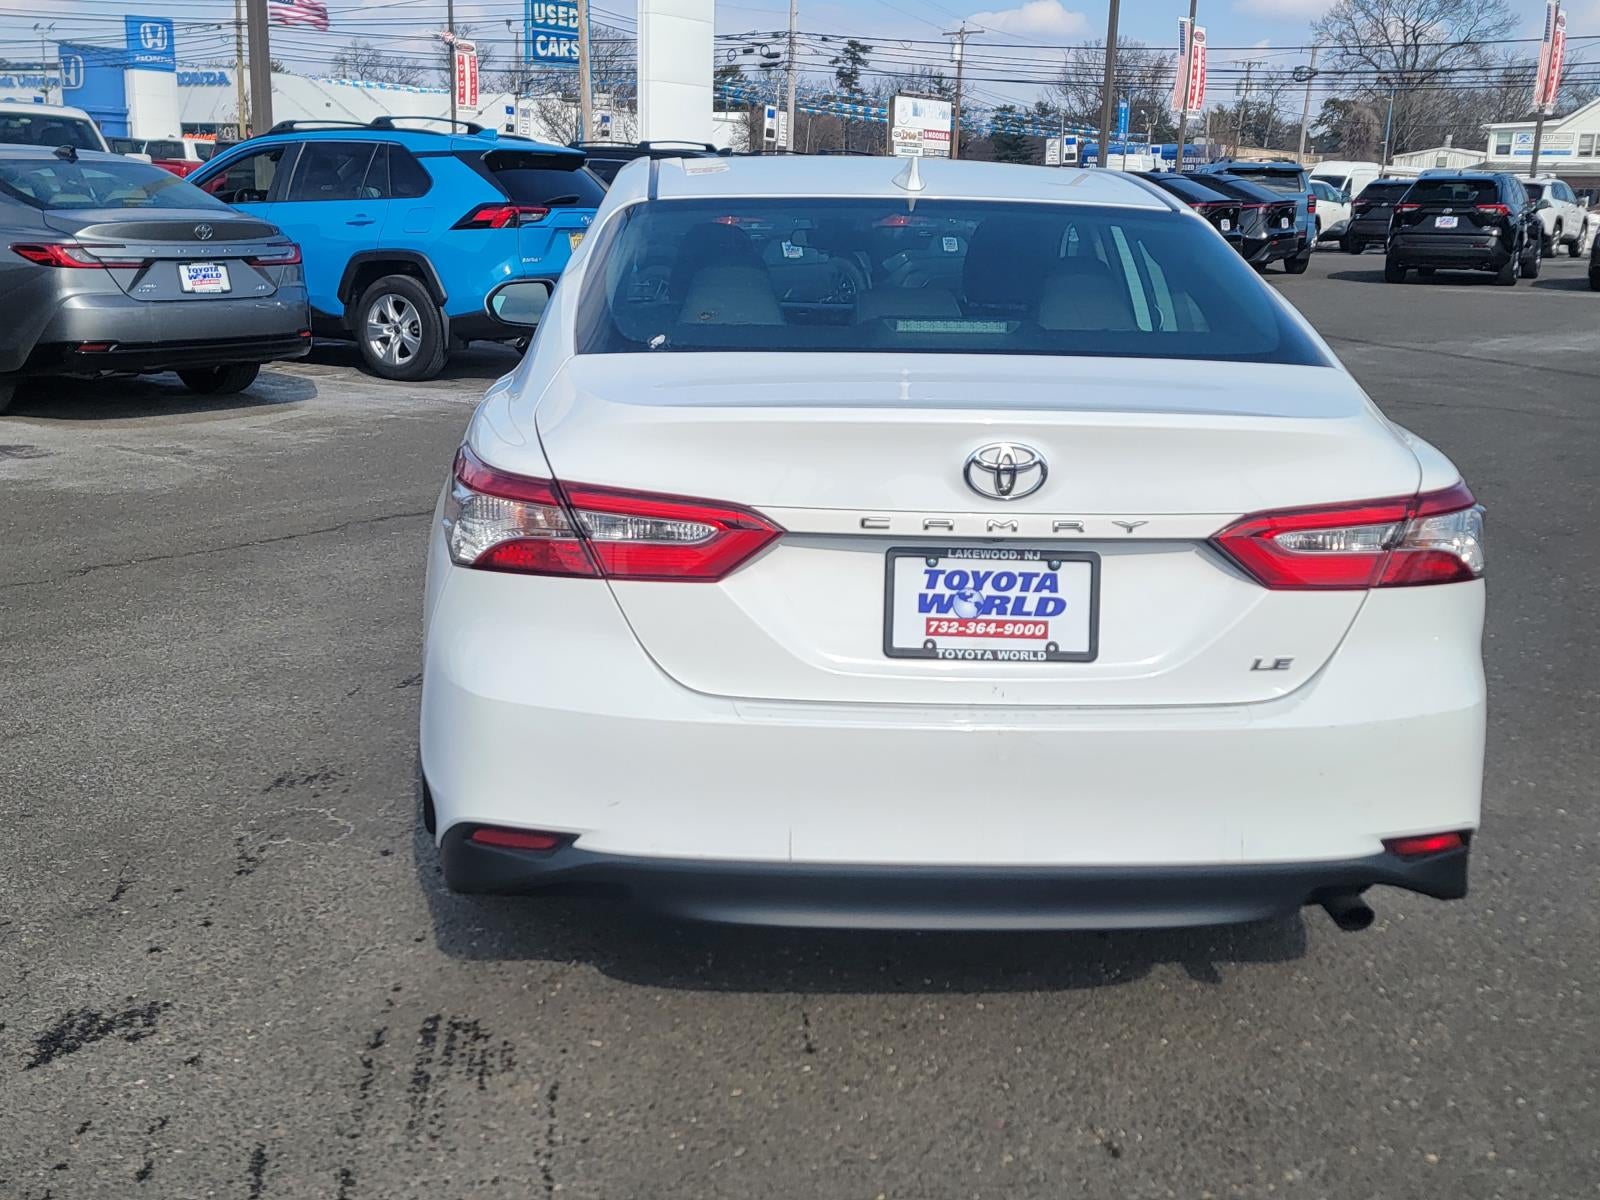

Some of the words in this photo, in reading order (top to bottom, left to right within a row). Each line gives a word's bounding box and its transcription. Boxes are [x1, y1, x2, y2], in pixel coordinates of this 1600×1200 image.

[533, 3, 578, 28] USED
[536, 35, 579, 59] CARS
[861, 516, 1149, 534] CAMRY
[1024, 551, 1041, 560] NJ
[923, 569, 1059, 593] TOYOTA
[928, 620, 1046, 636] 732-364-9000
[936, 649, 994, 660] TOYOTA
[998, 650, 1047, 661] WORLD
[1250, 658, 1295, 671] LE
